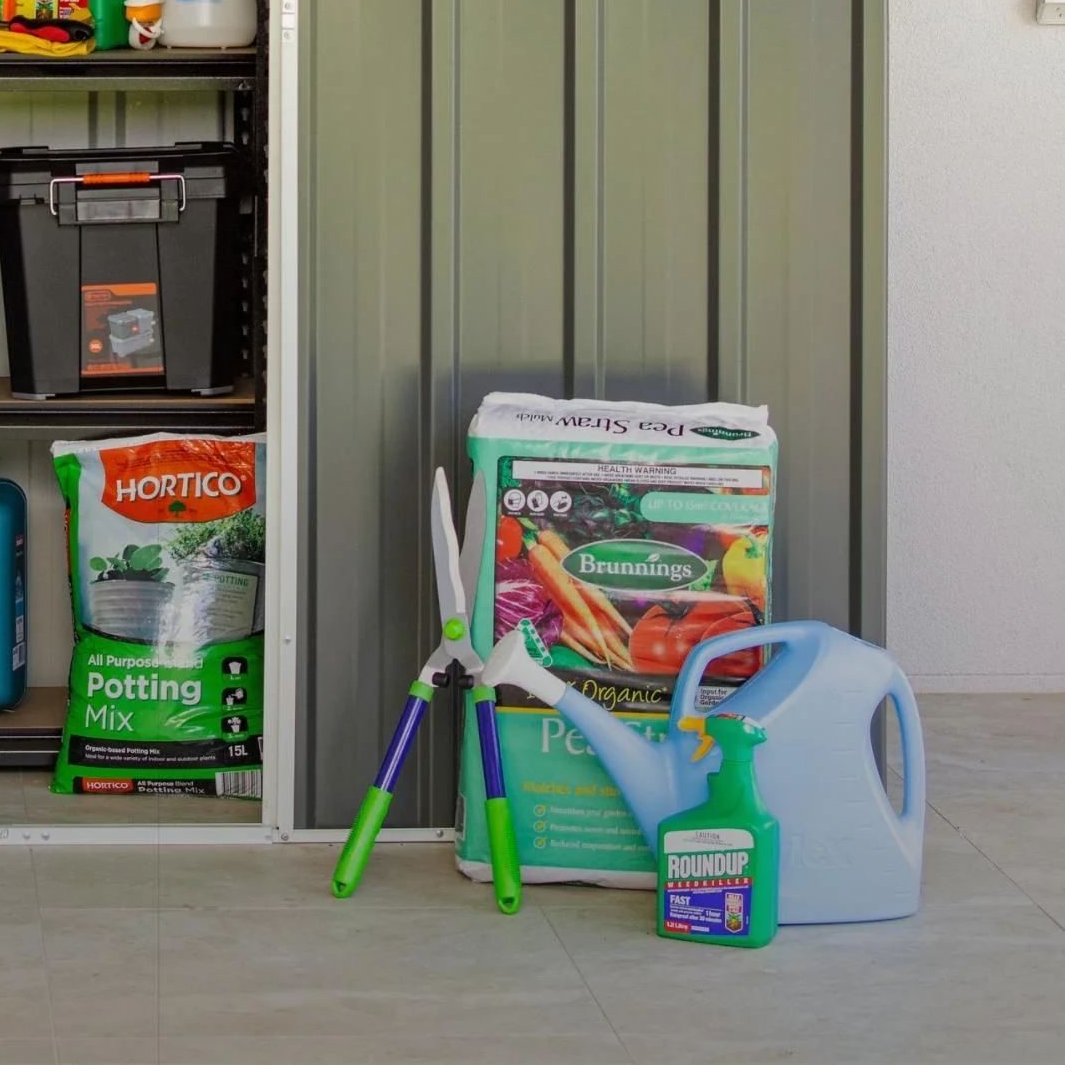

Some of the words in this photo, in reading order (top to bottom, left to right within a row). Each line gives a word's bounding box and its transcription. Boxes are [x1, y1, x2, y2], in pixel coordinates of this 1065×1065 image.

[556, 417, 628, 434] Straw
[638, 422, 684, 436] Pea
[597, 464, 633, 473] HEALTH
[634, 465, 677, 476] WARNING
[116, 471, 242, 503] HORTICO
[578, 553, 693, 581] Brunnings
[87, 654, 104, 666] All
[87, 671, 202, 706] Potting
[700, 688, 716, 696] Input
[85, 704, 135, 732] Mix
[541, 717, 596, 755] Pe
[85, 744, 126, 754] Organic-based
[126, 747, 149, 755] Potting
[228, 744, 248, 757] 15L
[86, 781, 129, 789] HORTICO
[667, 851, 749, 879] ROUNDUP
[667, 878, 749, 888] WEEDKILLER
[669, 894, 691, 905] FAST
